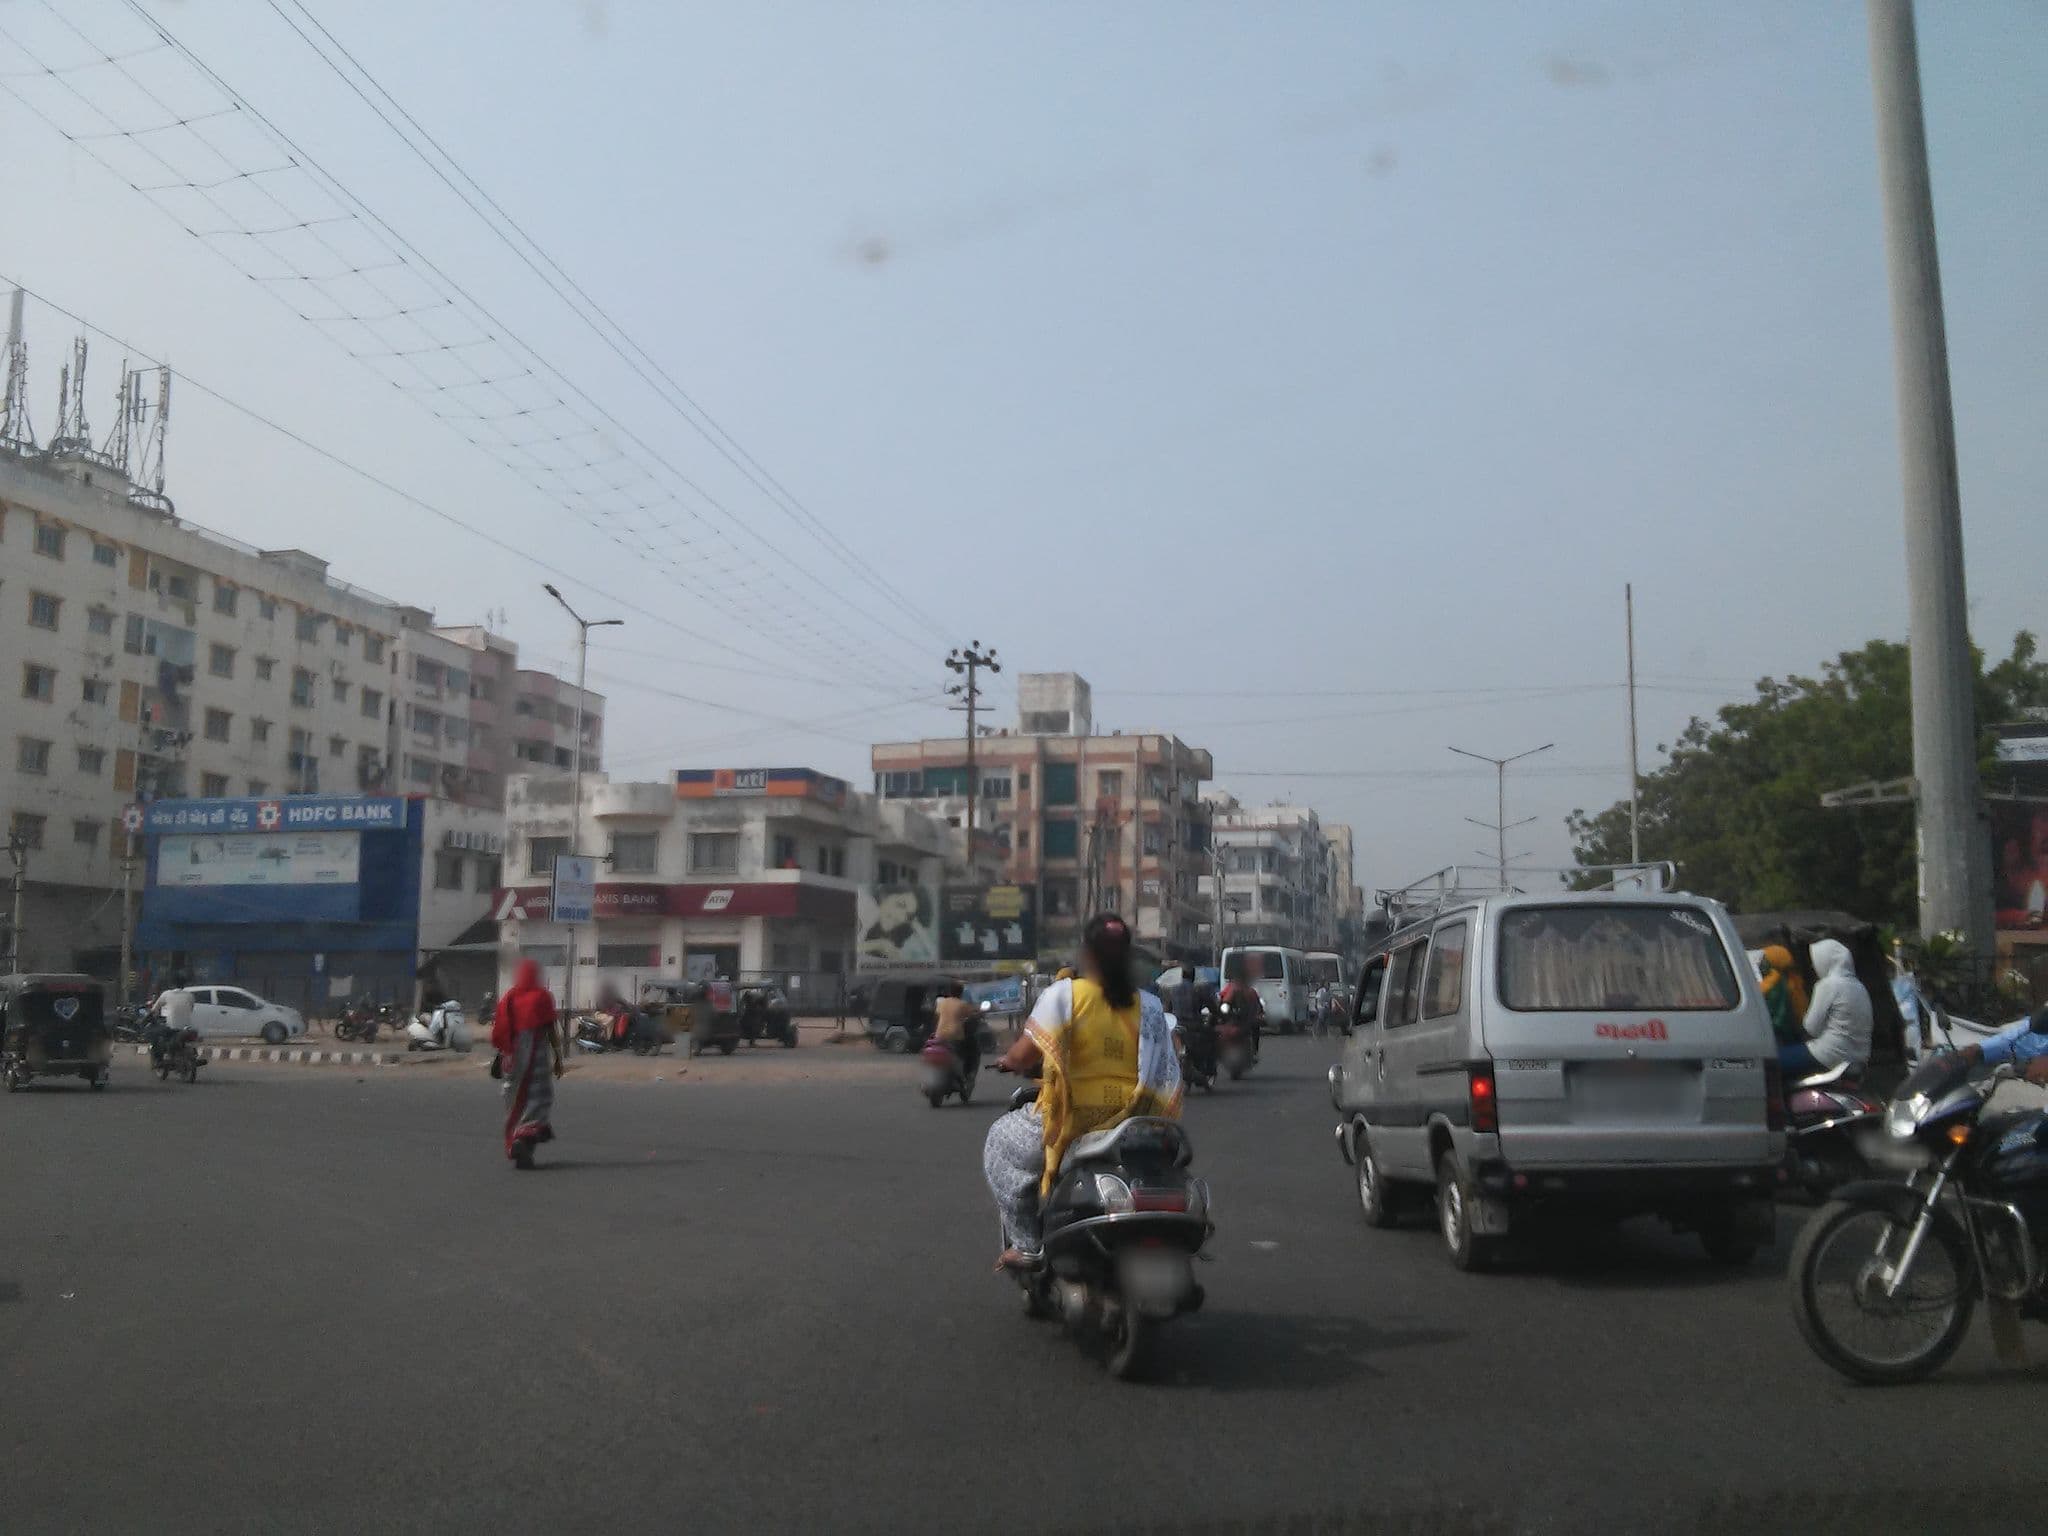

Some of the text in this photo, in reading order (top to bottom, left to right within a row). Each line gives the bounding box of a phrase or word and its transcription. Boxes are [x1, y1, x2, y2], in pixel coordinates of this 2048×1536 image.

[288, 804, 392, 822] HDFC BANK
[623, 893, 659, 905] BANK
[708, 895, 730, 904] ATM
